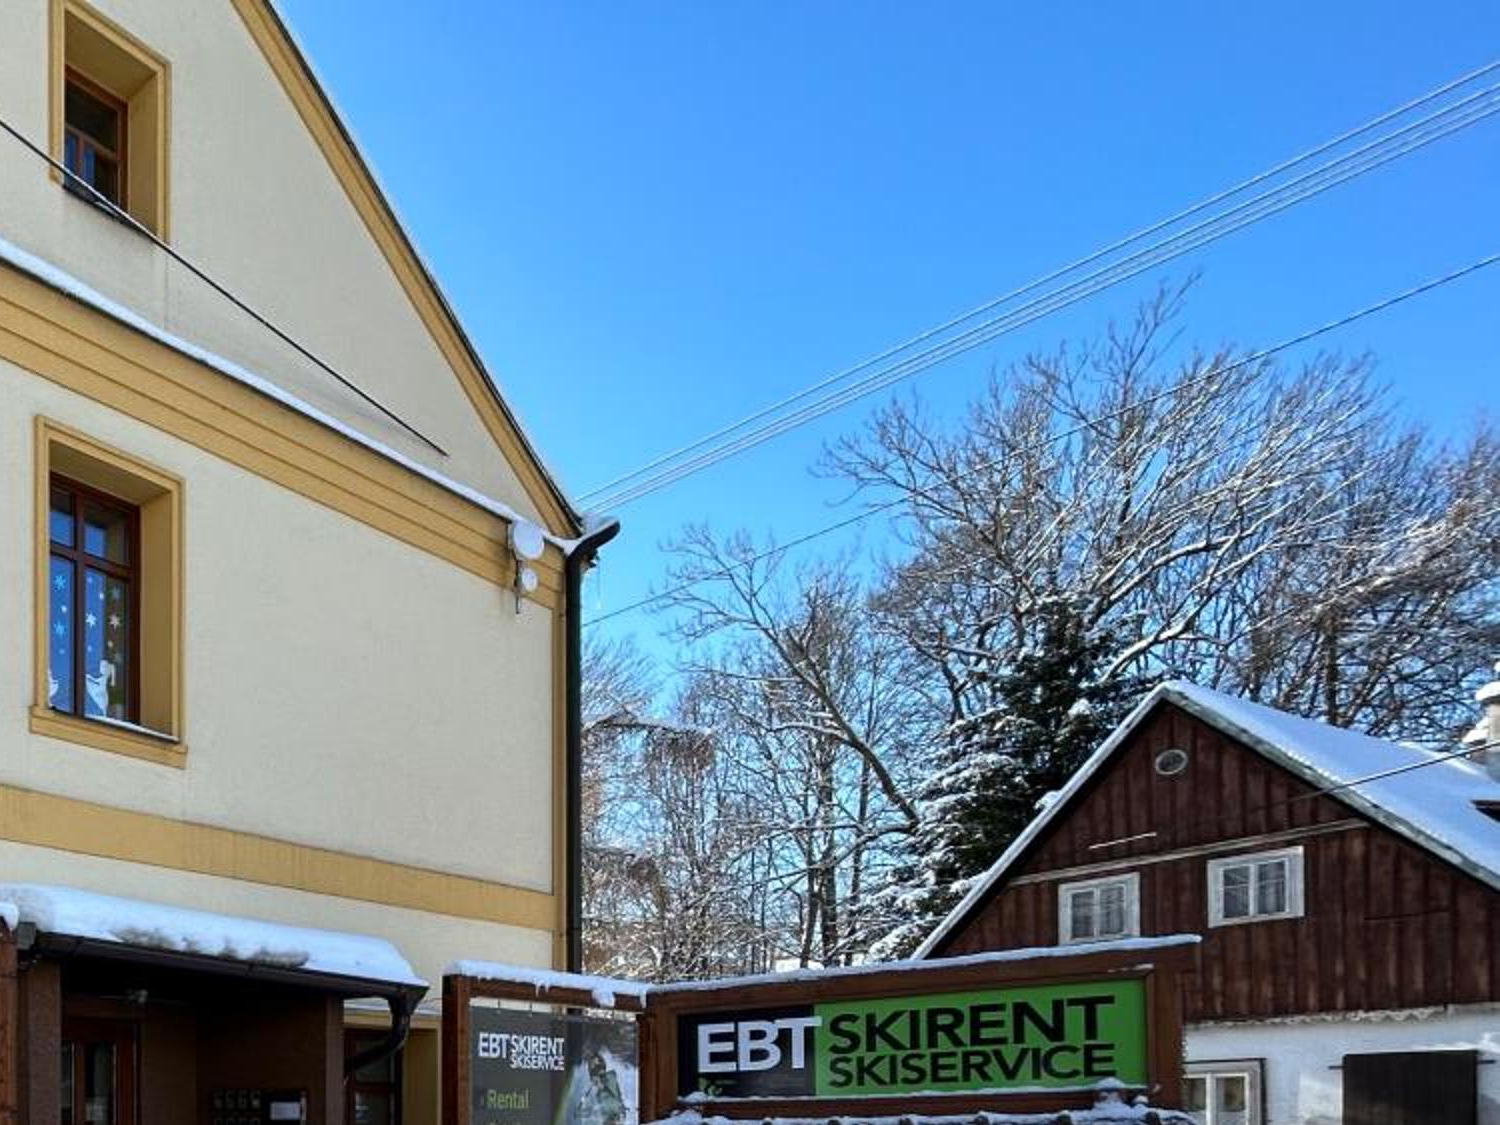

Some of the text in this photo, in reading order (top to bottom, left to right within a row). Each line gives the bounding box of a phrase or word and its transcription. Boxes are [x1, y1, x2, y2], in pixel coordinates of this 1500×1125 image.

[478, 1032, 565, 1059] EBT SKIRENT
[698, 995, 1116, 1073] EBT SKIRENT
[510, 1054, 565, 1071] SKISERVICE
[829, 1042, 1116, 1088] SKISERVICE
[486, 1089, 530, 1110] Rental
